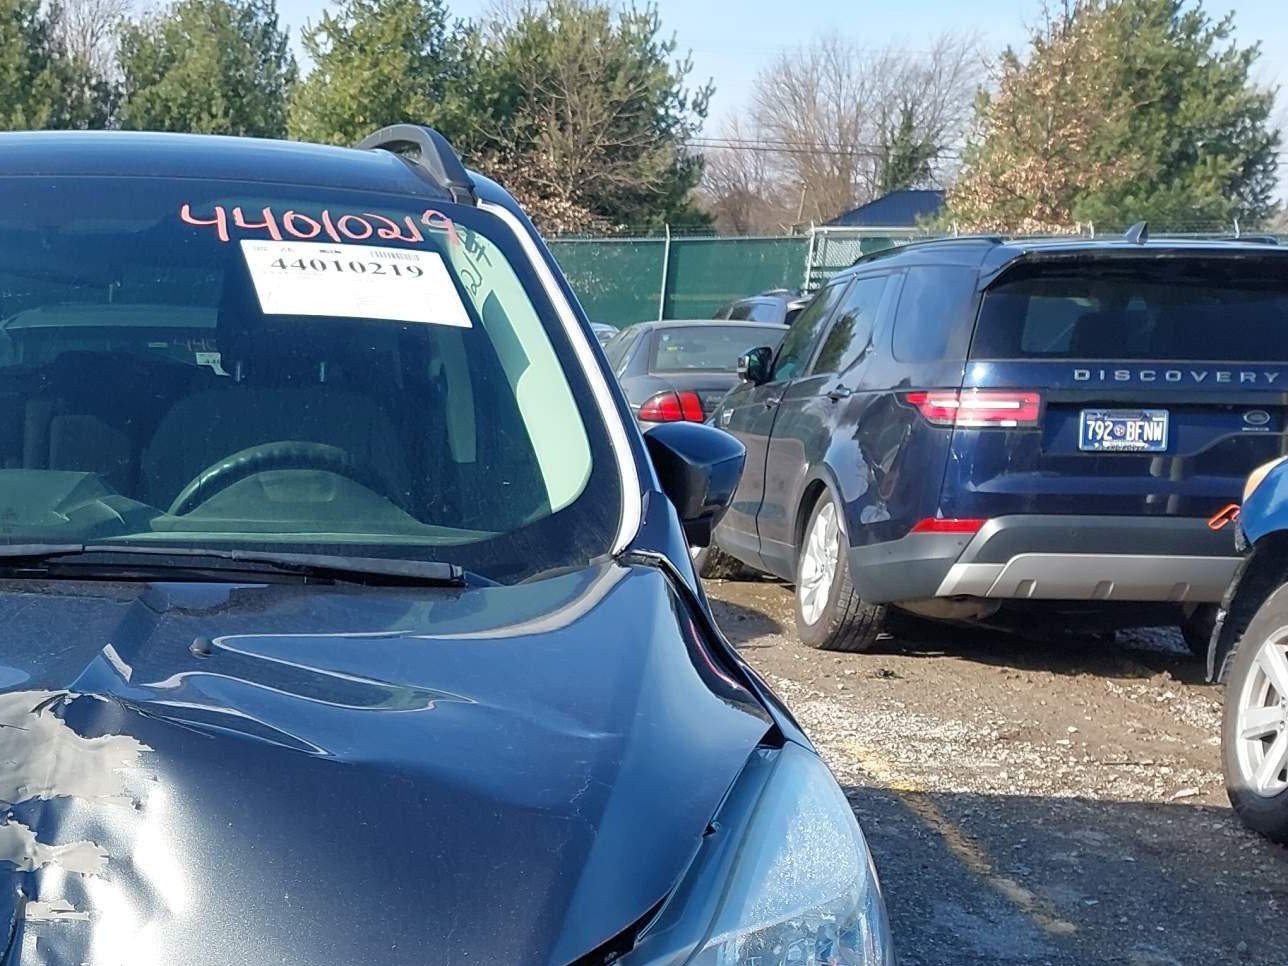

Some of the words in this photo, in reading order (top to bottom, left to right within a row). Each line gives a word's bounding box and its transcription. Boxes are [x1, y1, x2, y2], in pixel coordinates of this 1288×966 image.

[181, 203, 459, 246] 44010219
[270, 257, 424, 278] 44010219
[1074, 368, 1280, 383] DISCOVERY
[1086, 420, 1113, 441] 792
